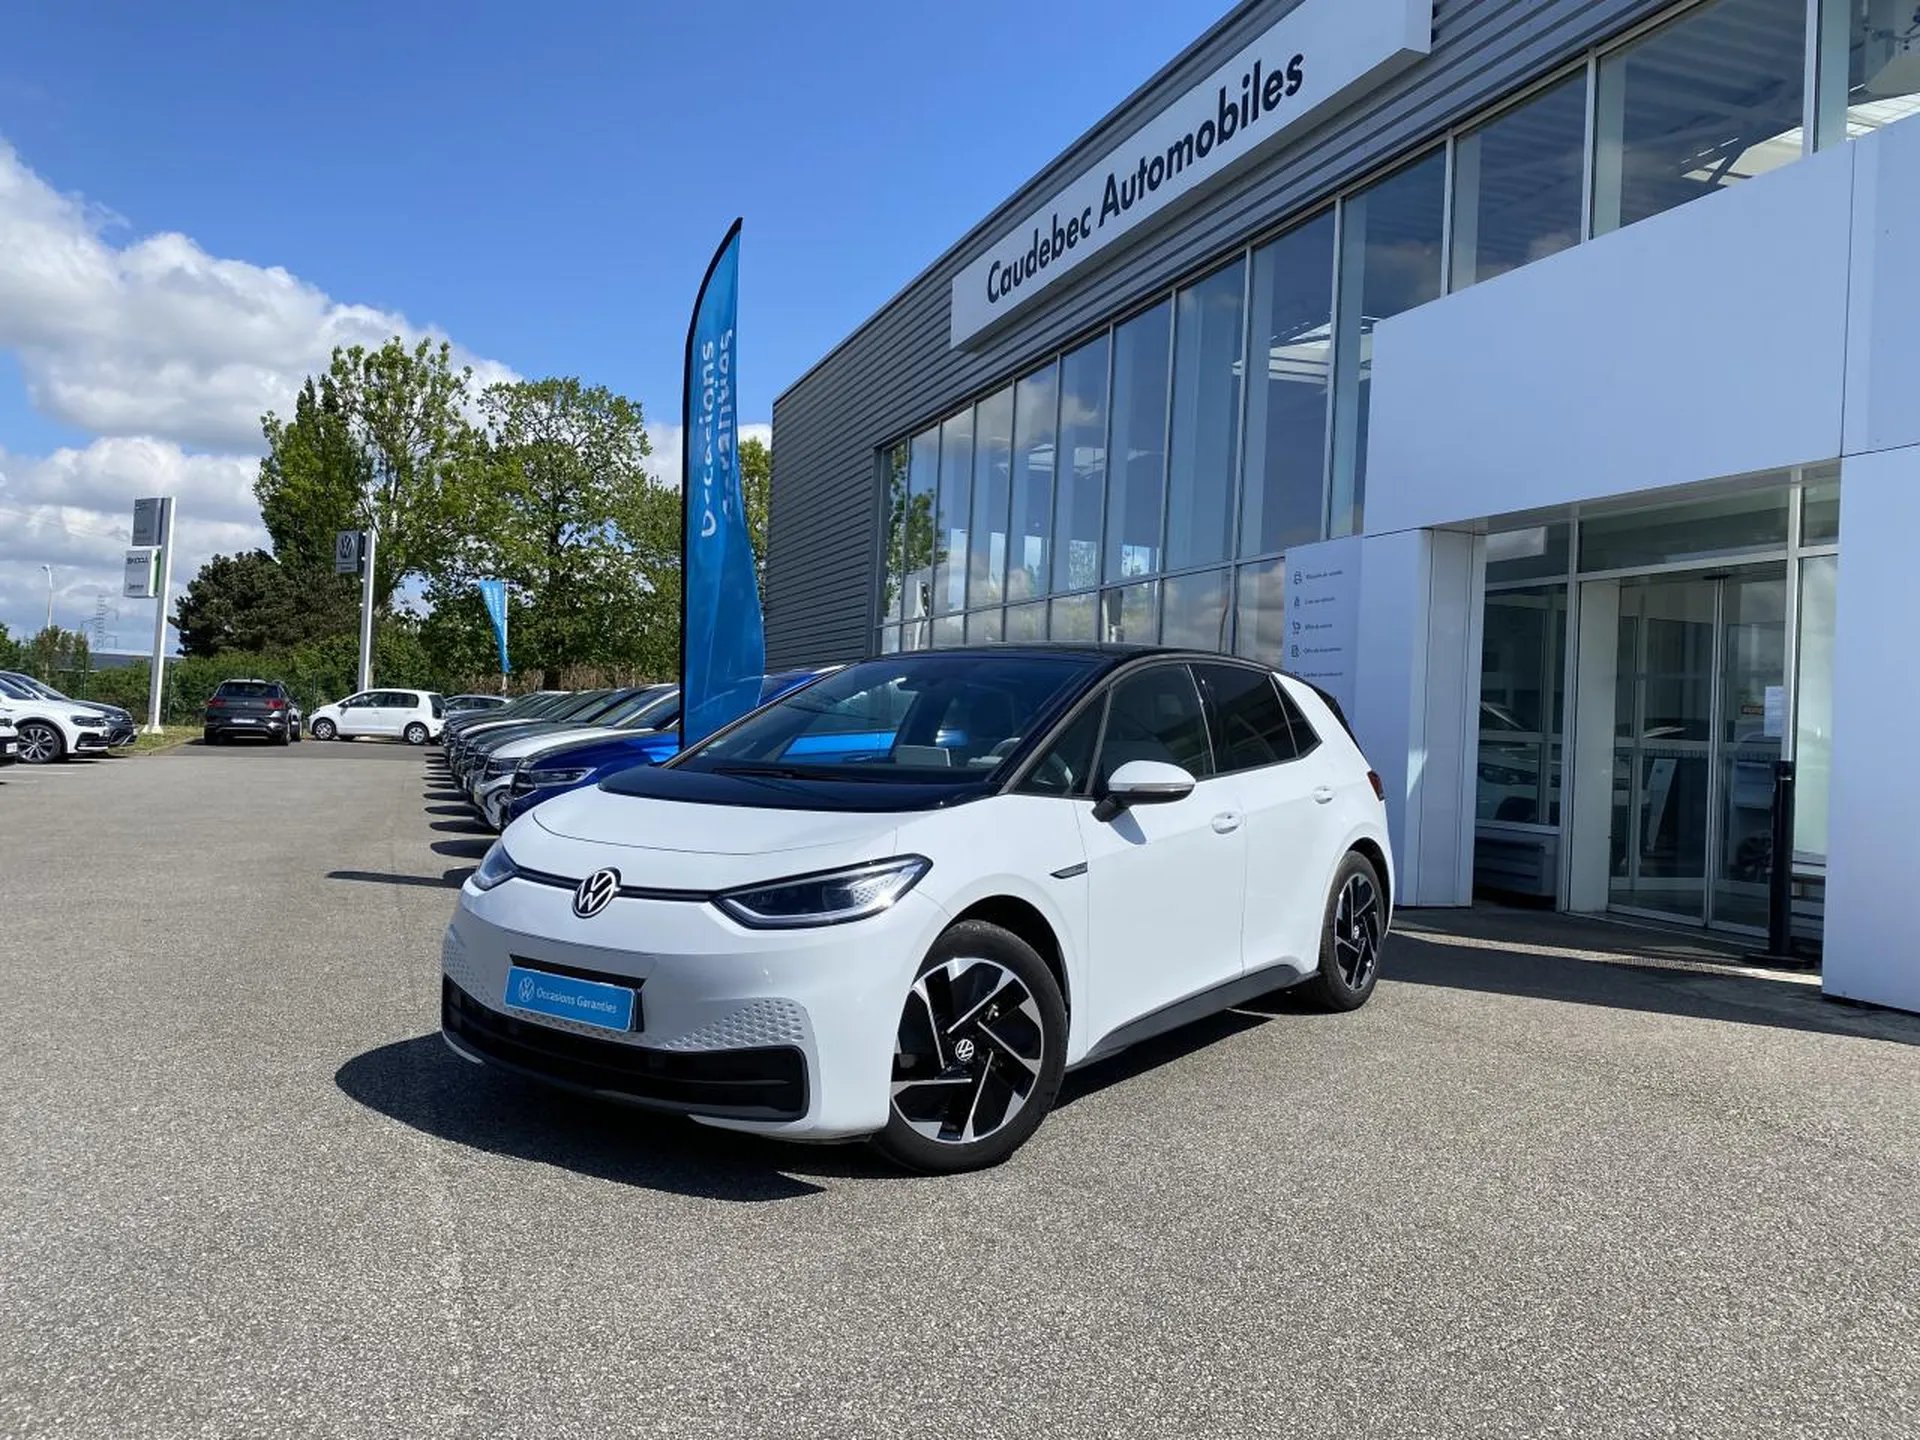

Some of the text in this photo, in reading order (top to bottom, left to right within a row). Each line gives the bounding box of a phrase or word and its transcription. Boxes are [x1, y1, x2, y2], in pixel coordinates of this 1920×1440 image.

[986, 53, 1303, 305] Caudebec Automobiles
[536, 987, 576, 1005] Occasions
[577, 995, 617, 1014] Garanties
